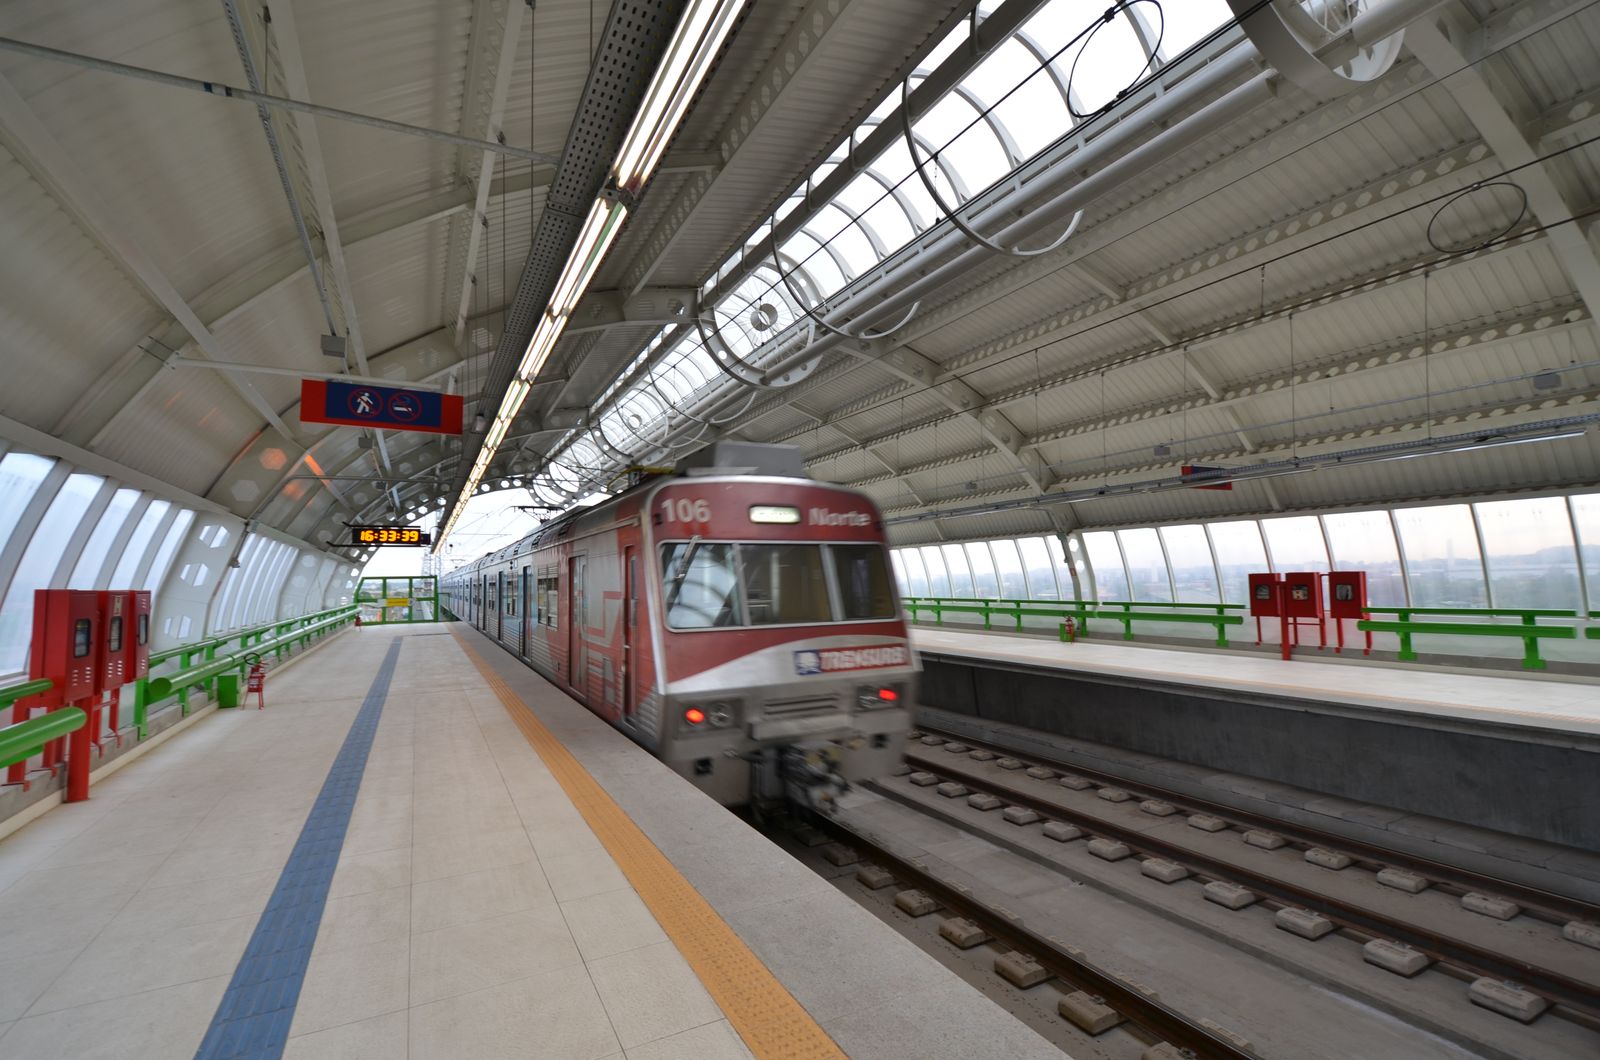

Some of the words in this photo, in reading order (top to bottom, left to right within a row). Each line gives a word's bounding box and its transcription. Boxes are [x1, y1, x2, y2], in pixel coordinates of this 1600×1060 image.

[661, 498, 711, 523] 106
[808, 507, 871, 526] Norte
[360, 530, 419, 542] 16:33:39
